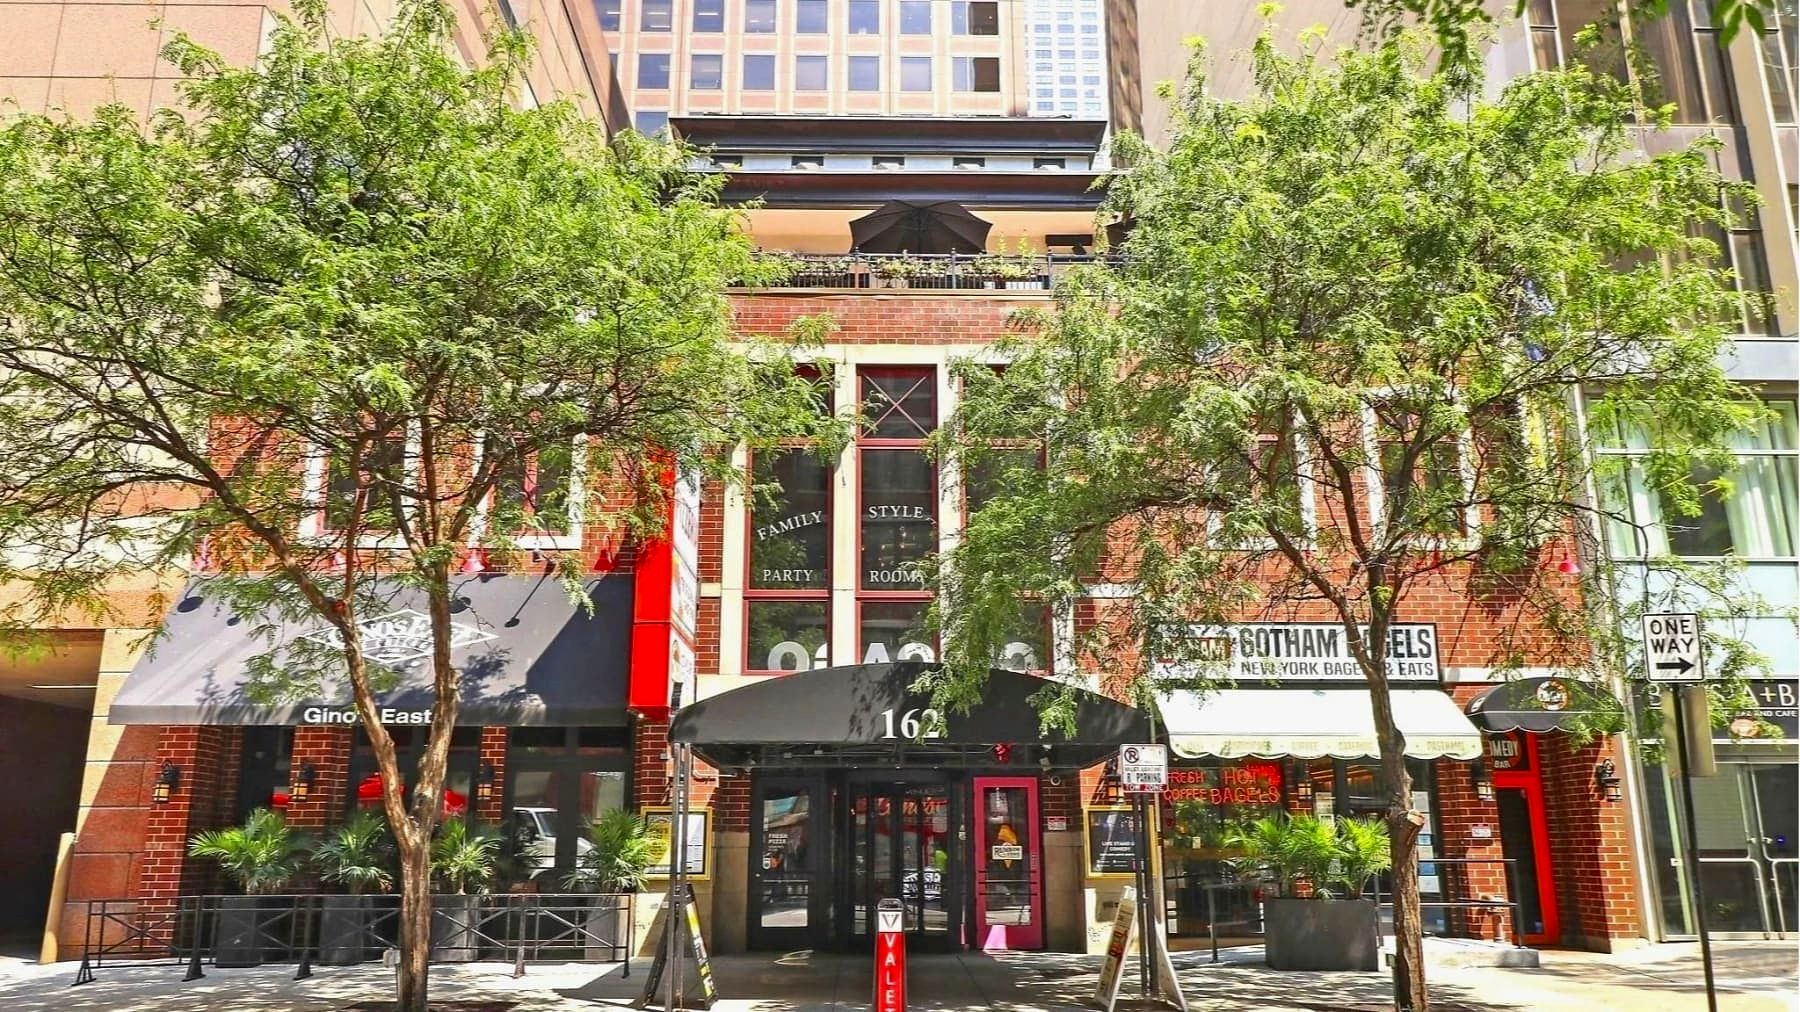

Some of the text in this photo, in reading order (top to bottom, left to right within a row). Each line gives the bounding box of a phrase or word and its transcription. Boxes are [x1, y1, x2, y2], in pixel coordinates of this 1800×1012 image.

[757, 505, 925, 541] FAMILY STYLE
[763, 569, 814, 582] PARTY
[1650, 619, 1693, 635] ONE
[1240, 628, 1339, 658] GOTHAM
[1347, 628, 1432, 658] ELS
[1651, 637, 1694, 653] WAY
[1242, 662, 1276, 675] NEW
[1281, 662, 1319, 675] YORK
[1324, 662, 1366, 676] BAGE
[1399, 662, 1434, 676] EATS
[382, 709, 433, 724] East
[881, 708, 941, 739] 162
[1494, 760, 1511, 769] BAR
[1223, 767, 1257, 785] HOT
[1163, 786, 1280, 805] COFFEE BAGELS
